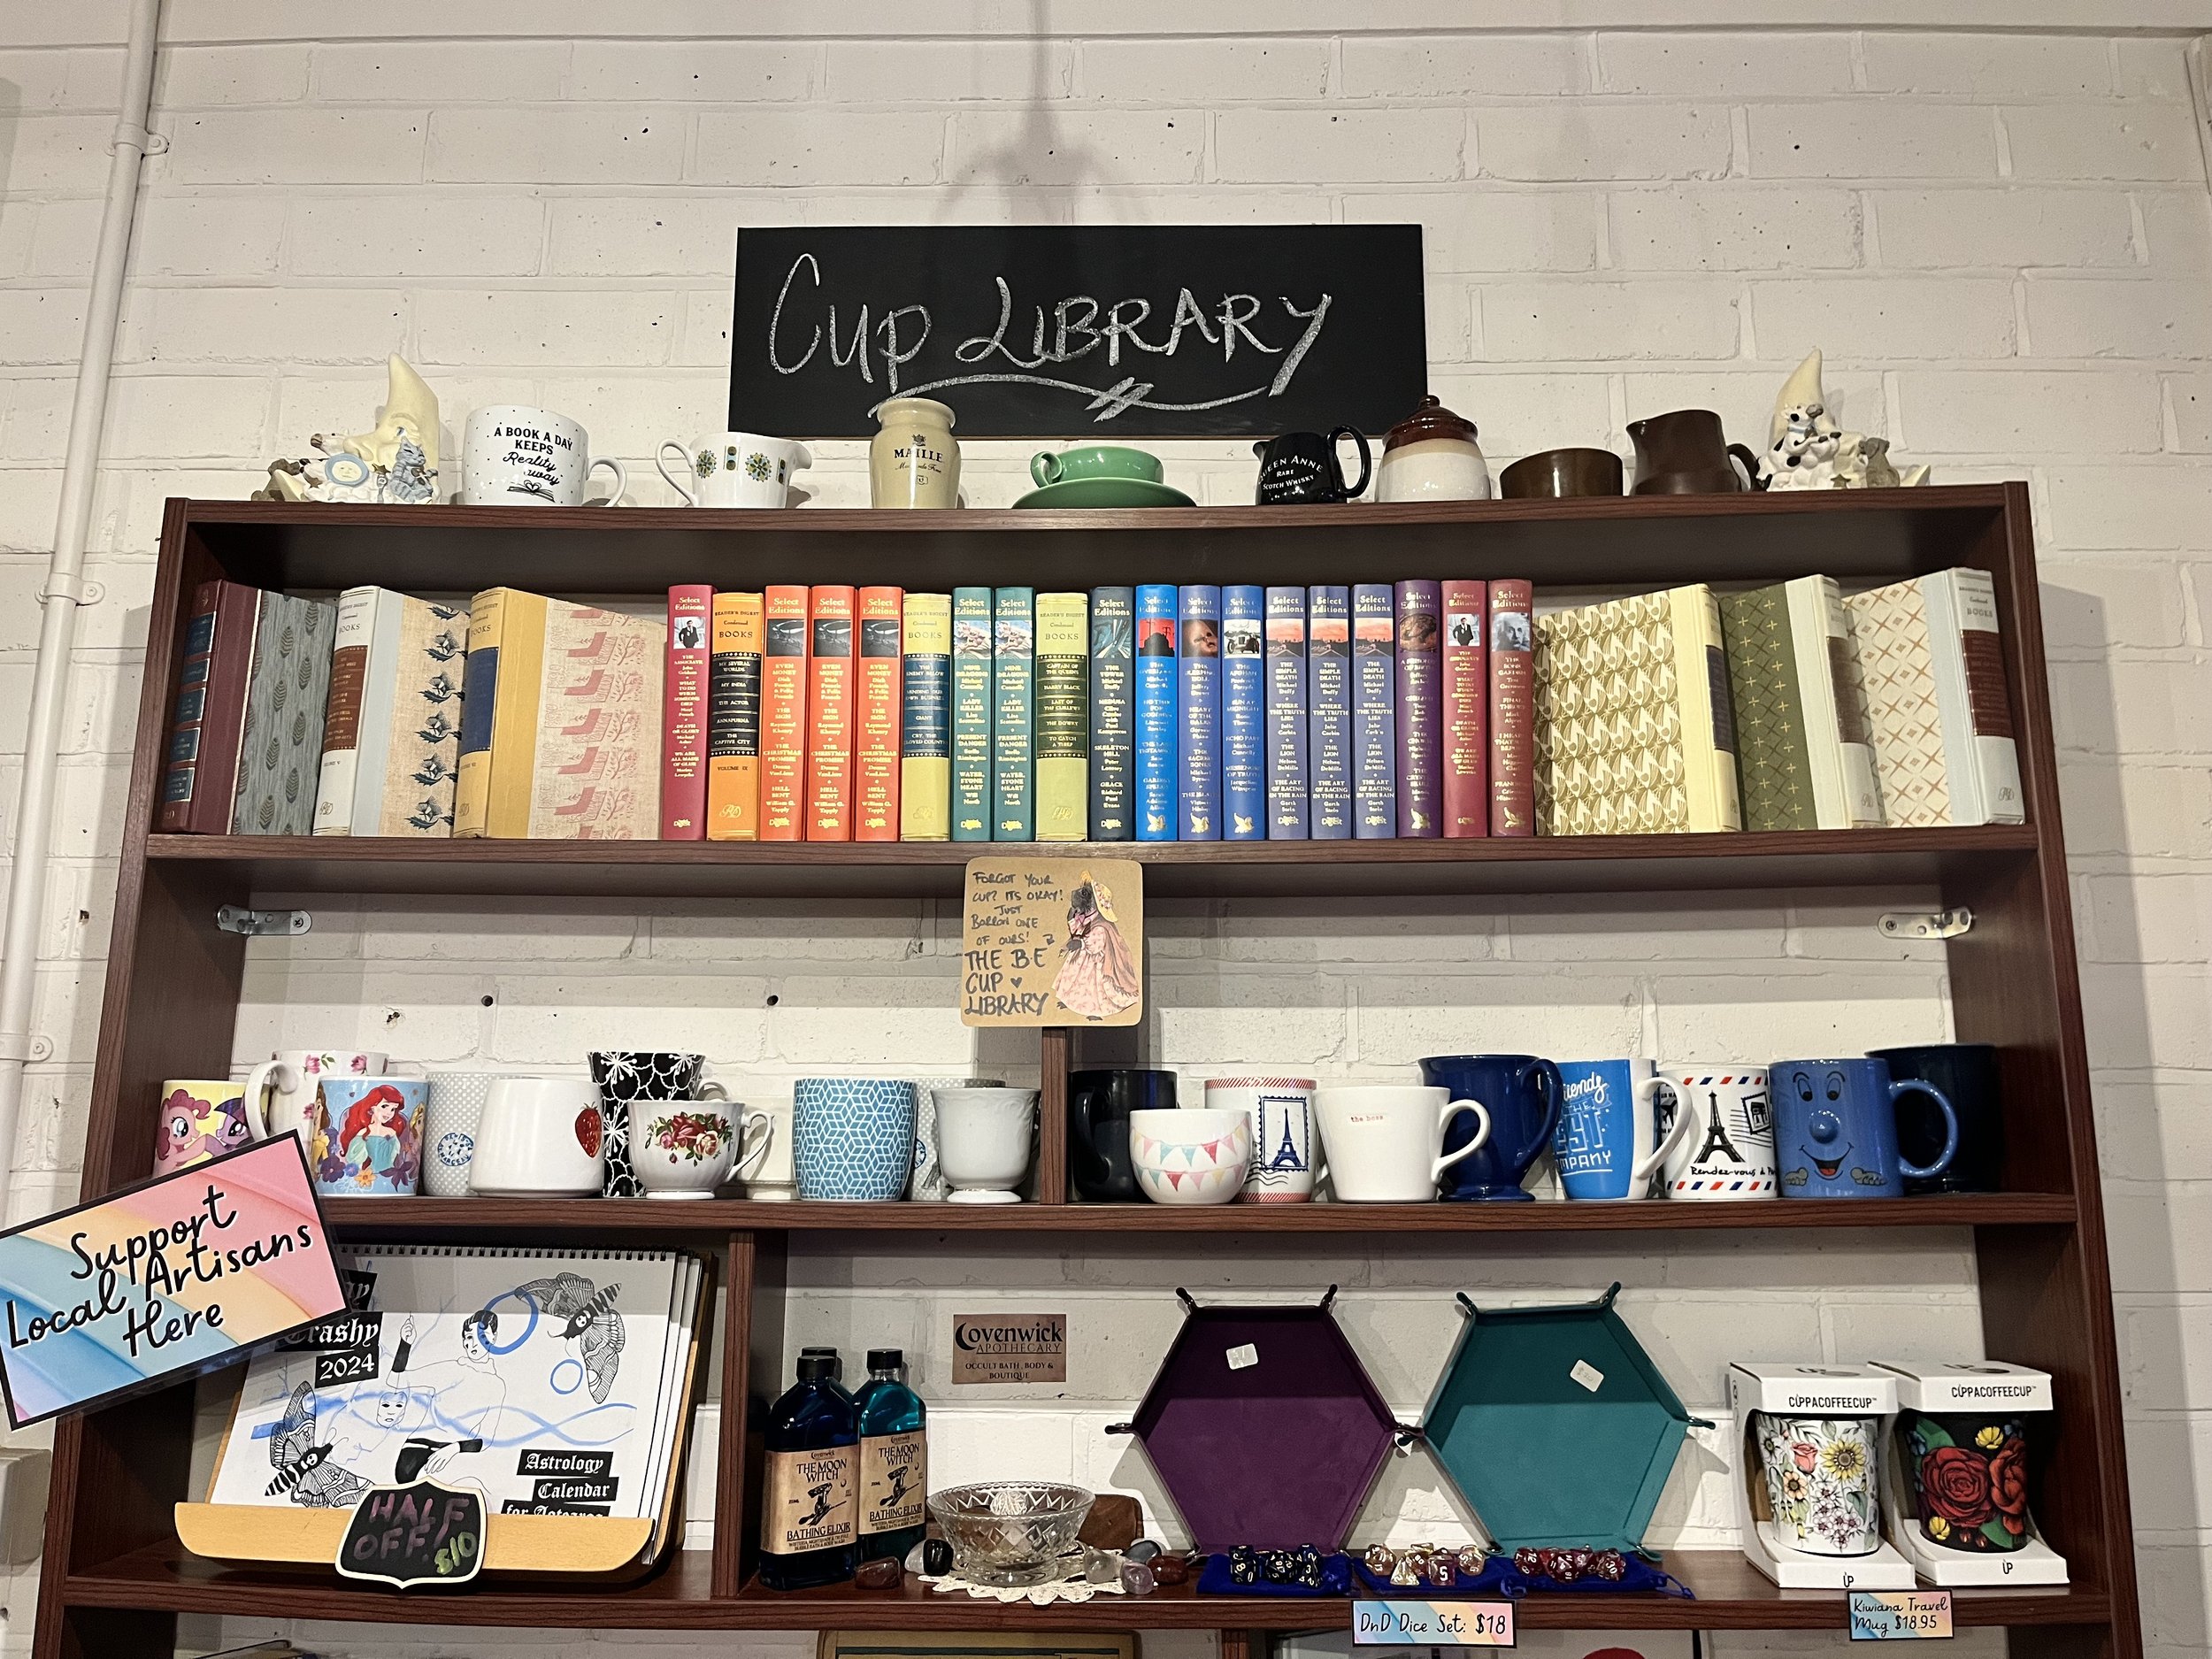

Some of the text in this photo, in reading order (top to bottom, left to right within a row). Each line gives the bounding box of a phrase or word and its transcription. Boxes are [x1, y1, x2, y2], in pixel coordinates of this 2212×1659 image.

[494, 427, 573, 450] A BOOK A DAY
[515, 440, 554, 455] KEEPS
[503, 452, 557, 472] Reality
[894, 449, 944, 463] MAILLE
[1291, 455, 1323, 472] ANNE
[1286, 474, 1314, 488] WHISKY
[1316, 595, 1342, 605] Select
[1359, 595, 1386, 603] Select
[976, 935, 990, 946] OF
[964, 949, 1002, 971] THE
[965, 972, 1003, 995] CUP
[964, 992, 1048, 1017] LIBRARY
[1690, 1165, 1755, 1177] Rendez-vous
[71, 1185, 237, 1285] Support
[6, 1224, 312, 1348] Local Artisans
[122, 1298, 224, 1357] Here
[956, 1321, 1063, 1351] Covenwick
[976, 1343, 1061, 1352] APOTHECARY
[319, 1353, 375, 1380] 2024
[879, 1443, 919, 1457] THE MOON
[526, 1453, 603, 1474] Astrology
[796, 1458, 847, 1474] THE MOON
[887, 1453, 913, 1465] WITCH
[806, 1469, 839, 1483] WITCH
[537, 1483, 610, 1499] Calendar
[369, 1493, 470, 1528] HALF
[870, 1507, 902, 1521] BATHING
[787, 1522, 850, 1540] BATHING ELIXIR
[1440, 1565, 1448, 1581] 5
[1854, 1596, 1948, 1612] Kiwiana Travel
[1361, 1612, 1506, 1634] DnD Dice Set: $18
[1855, 1615, 1937, 1638] Mug $18.95
